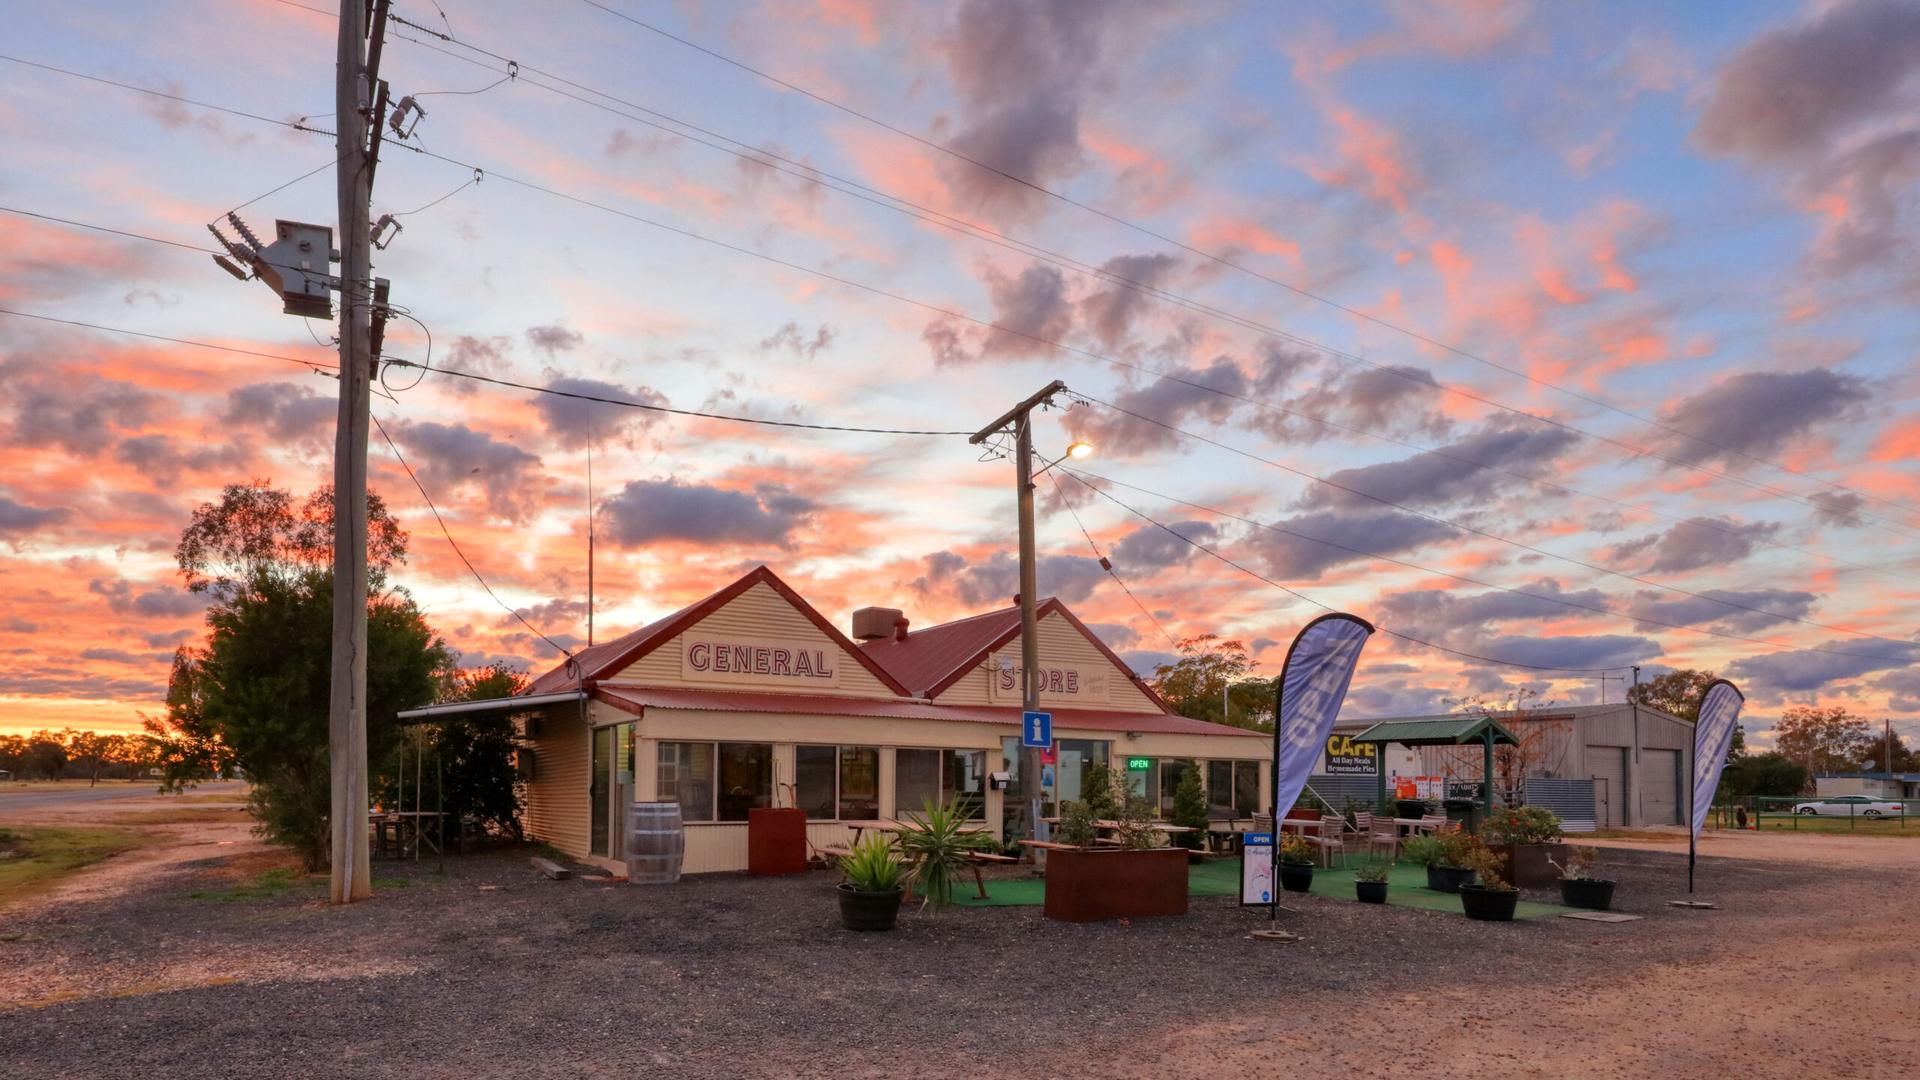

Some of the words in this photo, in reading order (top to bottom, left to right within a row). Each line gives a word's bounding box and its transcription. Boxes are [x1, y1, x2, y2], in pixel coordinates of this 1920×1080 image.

[688, 641, 833, 679] GENERAL
[1129, 759, 1149, 769] OPEN
[1341, 757, 1352, 765] Day
